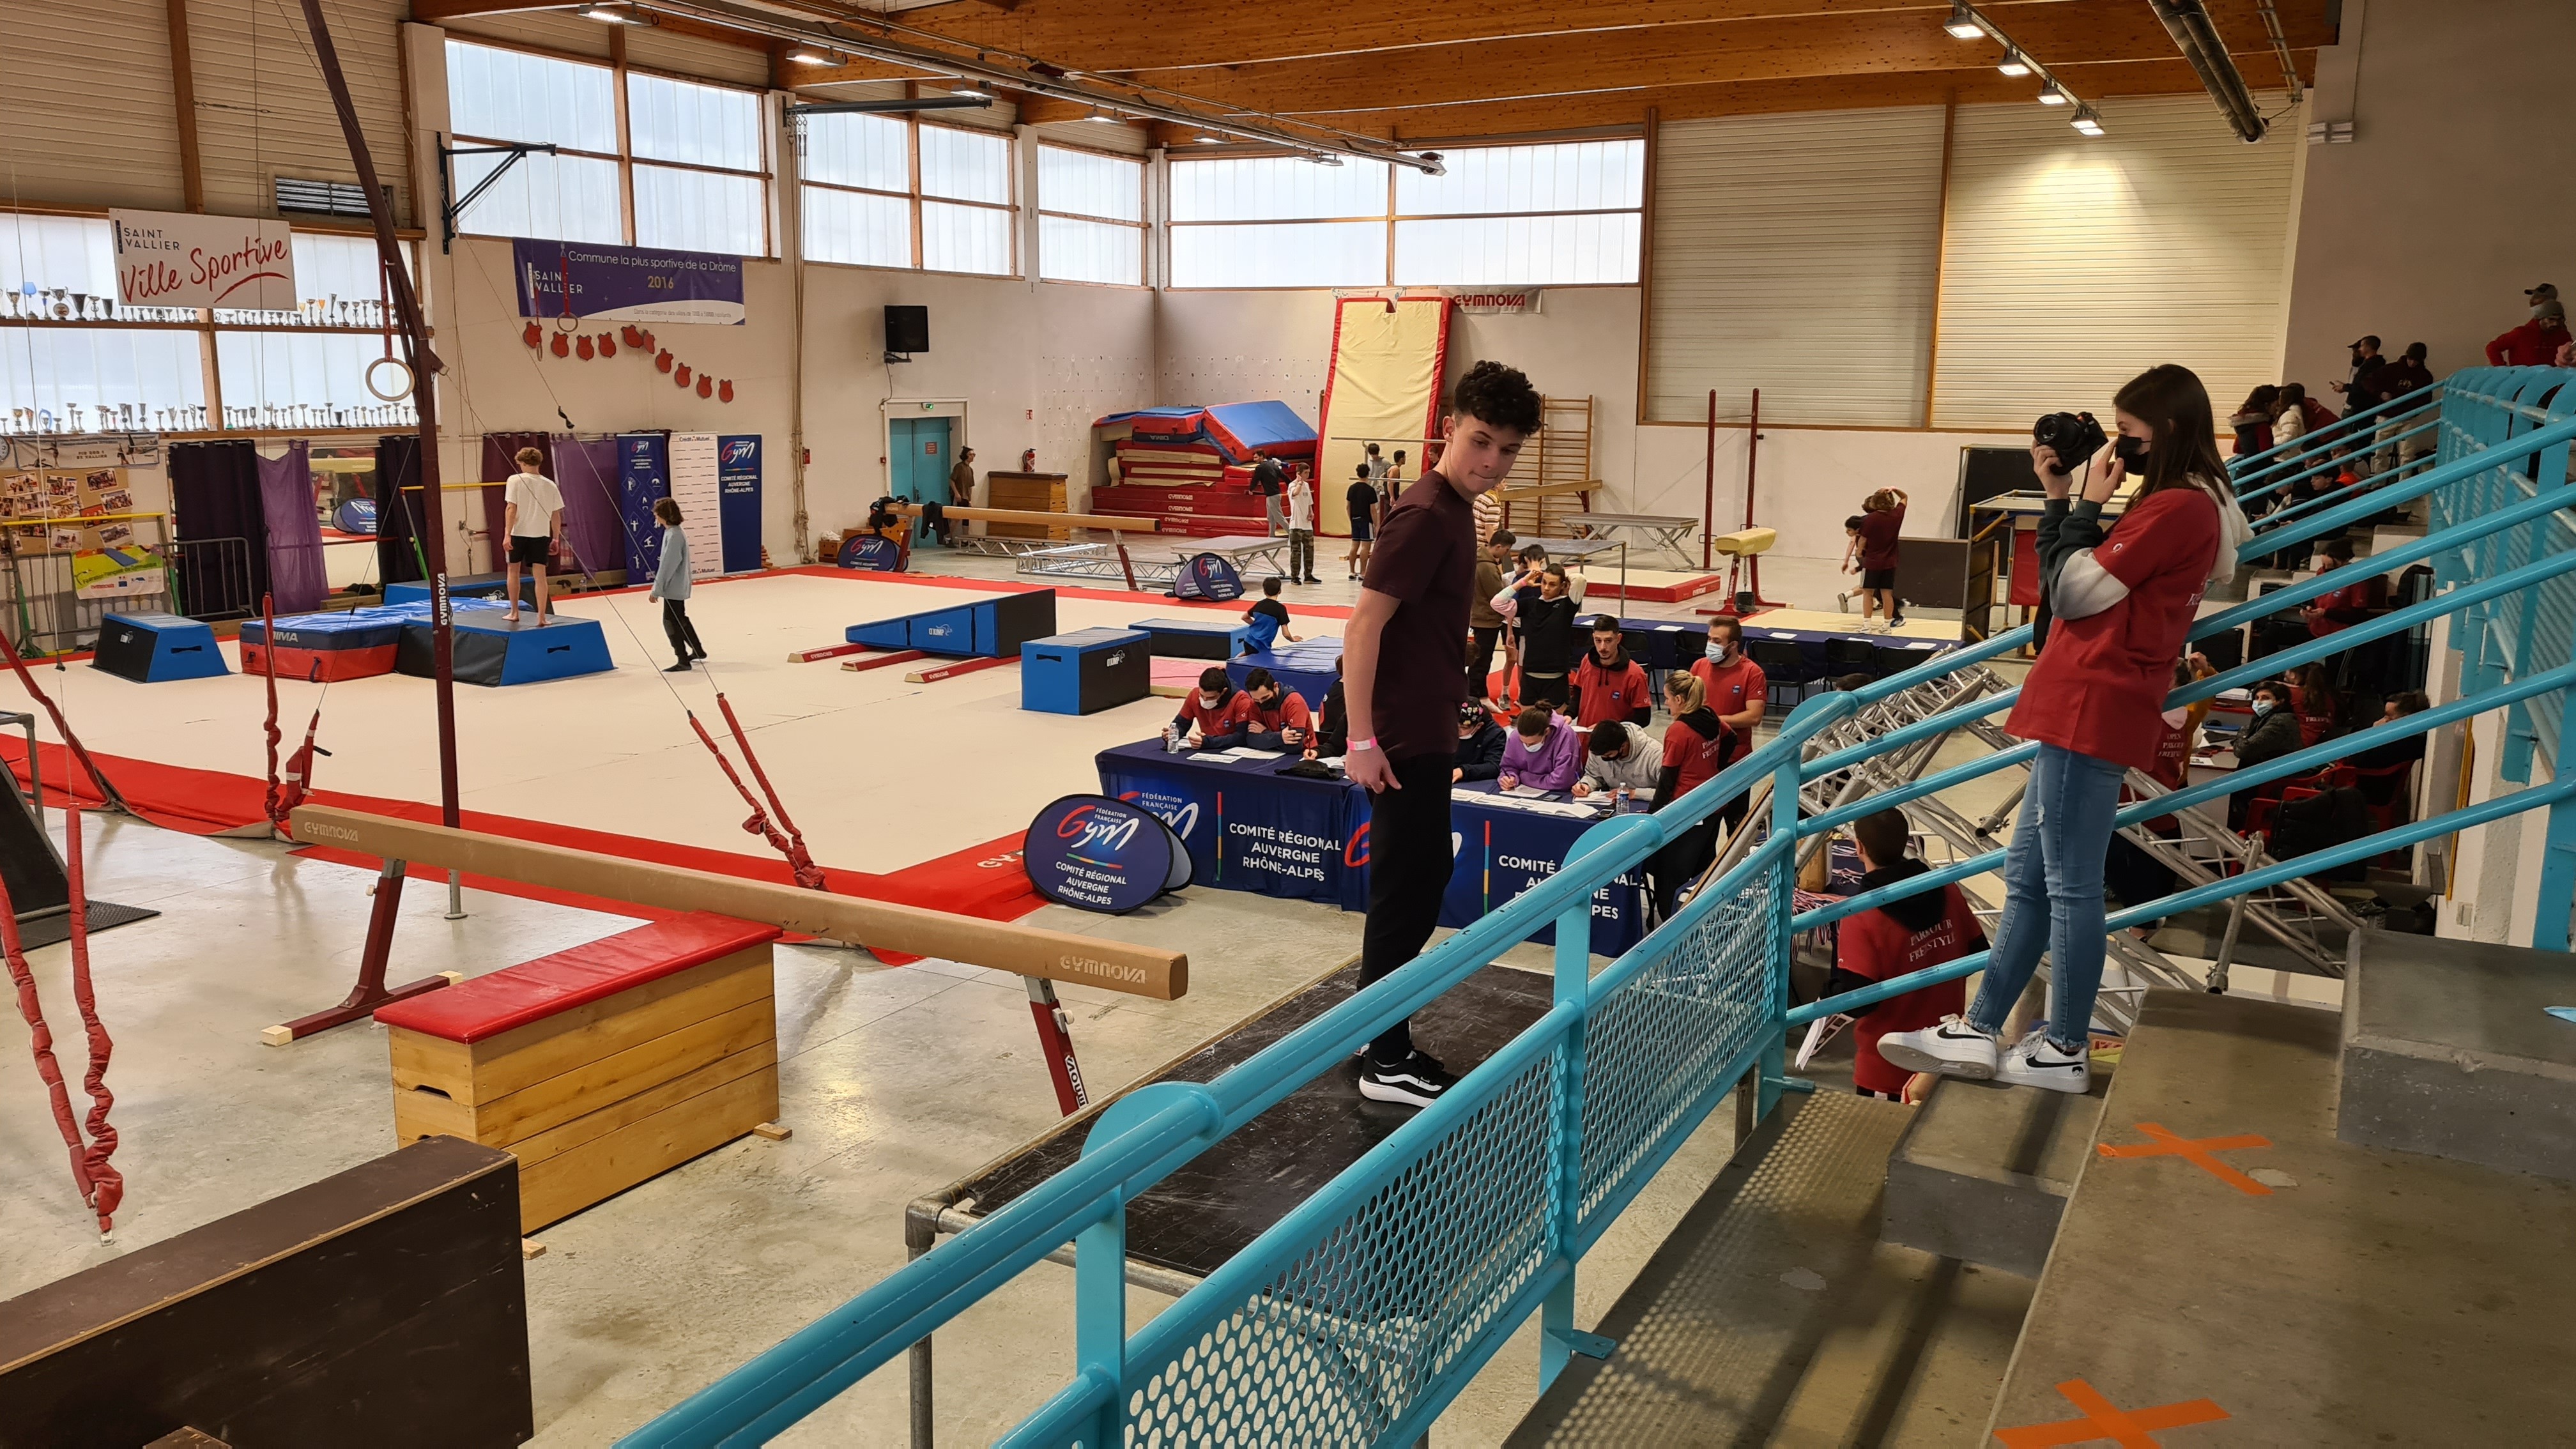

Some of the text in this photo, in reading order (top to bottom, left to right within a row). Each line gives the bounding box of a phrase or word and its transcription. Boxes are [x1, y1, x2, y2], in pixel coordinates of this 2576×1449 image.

[124, 227, 163, 238] SAINT
[125, 238, 180, 250] VALLIER
[121, 236, 288, 303] Ville Sportive
[568, 251, 736, 272] Commune la plus sportive de la Drôme
[535, 270, 569, 282] SAIN
[647, 275, 674, 289] 2016
[535, 282, 583, 294] VALLER
[1453, 294, 1526, 307] GYMNOVA
[437, 572, 448, 625] GYMNOVA
[1142, 791, 1183, 804] FÉDÉRATION
[1142, 800, 1178, 811] FRANÇAISE
[1094, 813, 1123, 825] FRANÇAISE
[1096, 807, 1128, 819] FÉDÉRATION
[303, 821, 360, 842] GYMNOVA
[1229, 822, 1275, 840] COMITÉ
[1278, 830, 1342, 852] RÉGIONAL
[1251, 841, 1321, 864] AUVERGNE
[1055, 861, 1128, 885] COMITÉ RÉGIONAL
[1243, 855, 1325, 882] RHÔNE-ALPES
[1498, 854, 1556, 875] COMITÉ
[1057, 884, 1112, 905] RHÔNE-ALPES
[1066, 876, 1110, 894] AUVERGNE
[1059, 954, 1147, 985] GYMNOVA
